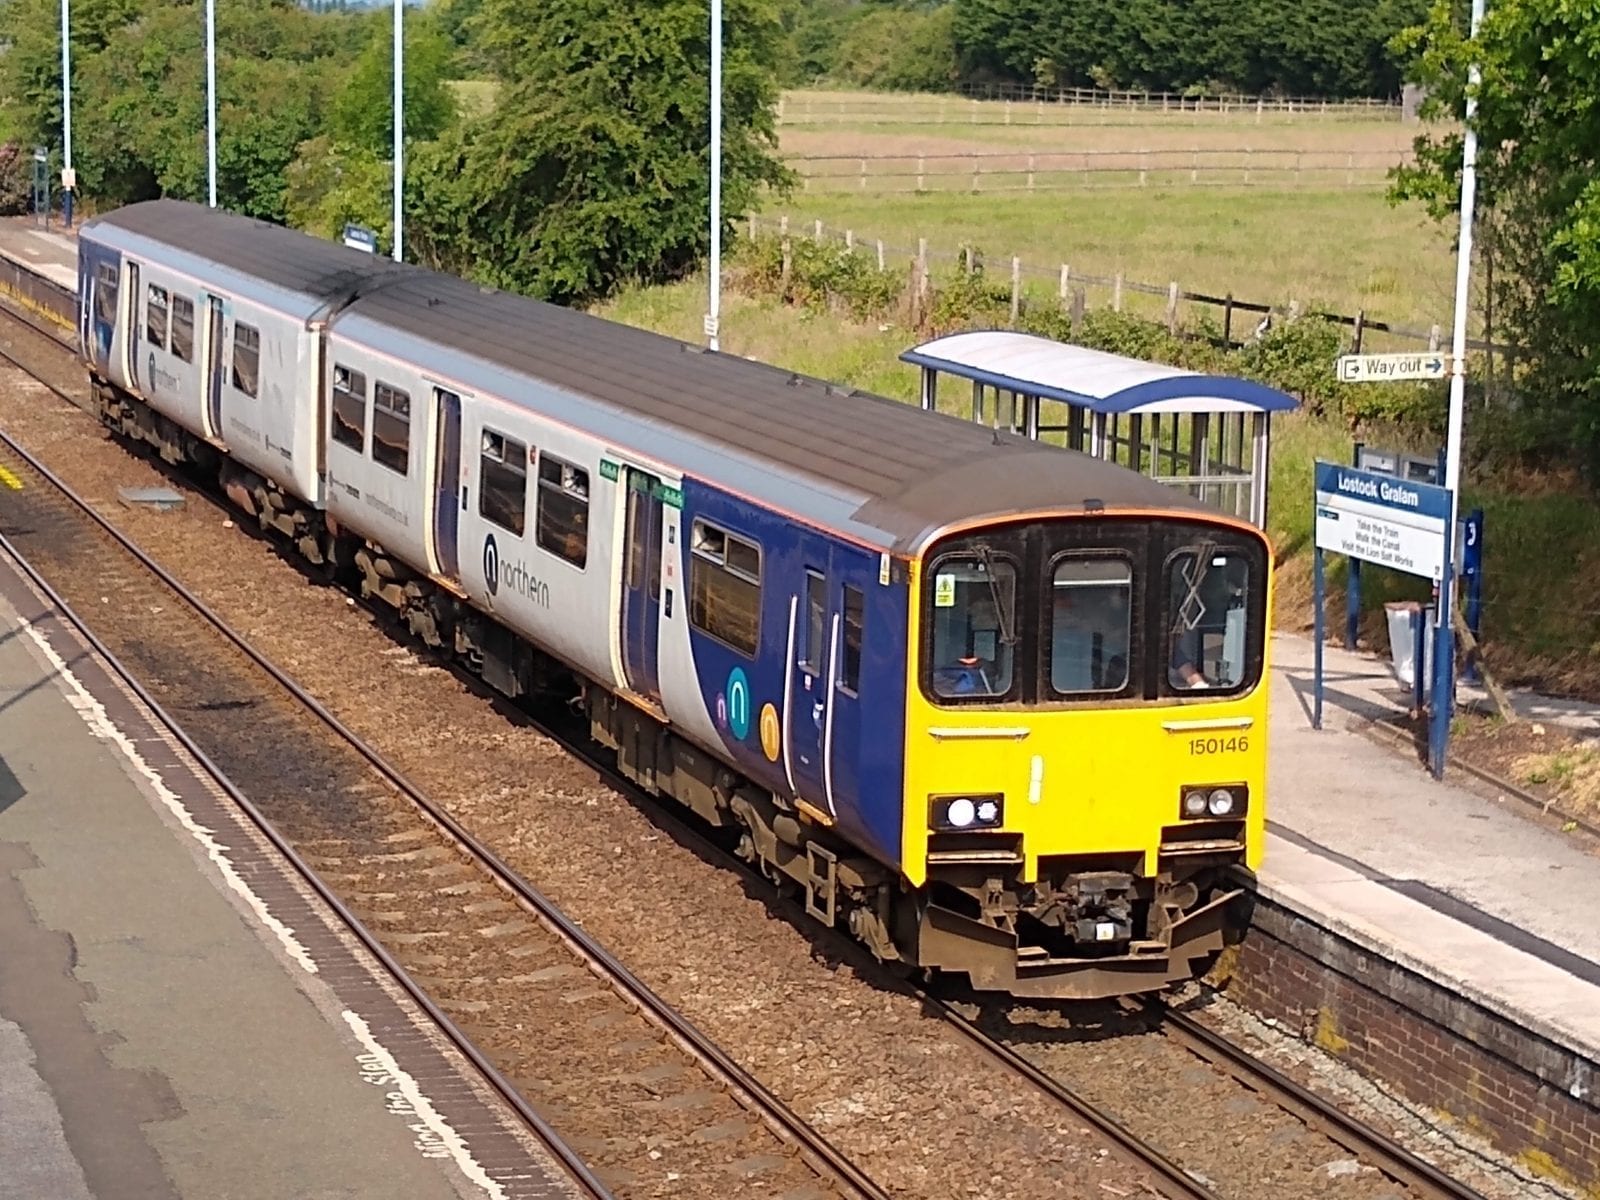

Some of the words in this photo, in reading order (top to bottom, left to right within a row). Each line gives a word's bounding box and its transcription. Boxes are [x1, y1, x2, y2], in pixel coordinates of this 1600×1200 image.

[1366, 360, 1395, 375] Way
[1400, 358, 1421, 373] out
[1338, 472, 1378, 498] Lostock
[1380, 482, 1418, 507] Gralam
[1356, 519, 1371, 532] Take
[1372, 523, 1382, 534] the
[1384, 526, 1399, 538] Train
[1341, 540, 1354, 552] Visit
[1356, 544, 1366, 555] the
[1366, 546, 1380, 558] Lion
[1355, 531, 1370, 543] Walk
[1371, 534, 1381, 545] the
[1382, 538, 1400, 551] Canal
[500, 558, 550, 609] northern
[1188, 736, 1249, 756] 150146
